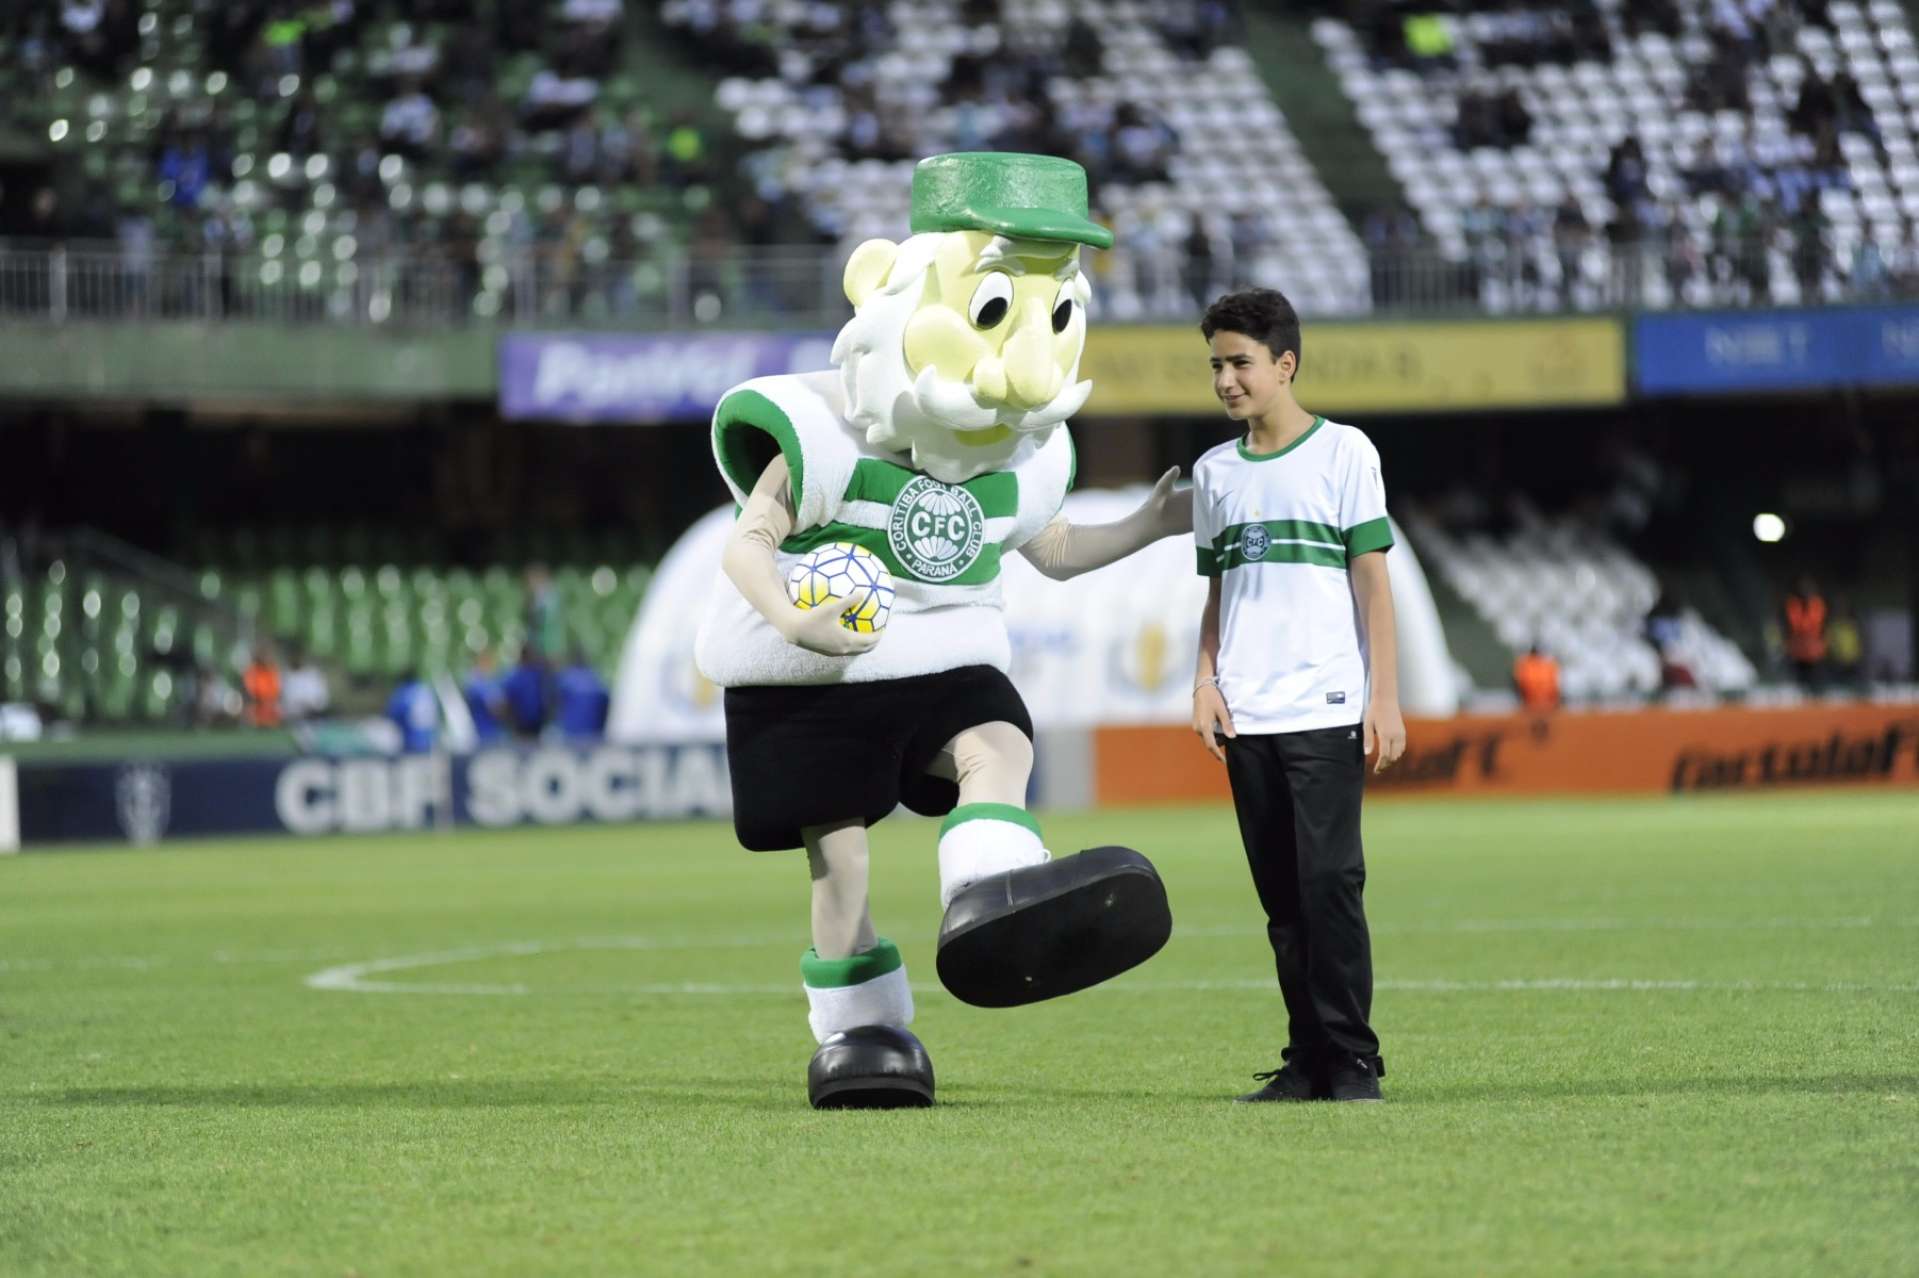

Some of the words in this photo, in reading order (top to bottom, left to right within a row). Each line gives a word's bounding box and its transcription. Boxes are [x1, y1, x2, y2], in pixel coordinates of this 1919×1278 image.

[893, 487, 919, 551] CORITIBA
[950, 486, 977, 518] BALL
[965, 521, 982, 558] CLUB
[911, 511, 966, 541] CFC
[467, 748, 728, 826] SOCIA
